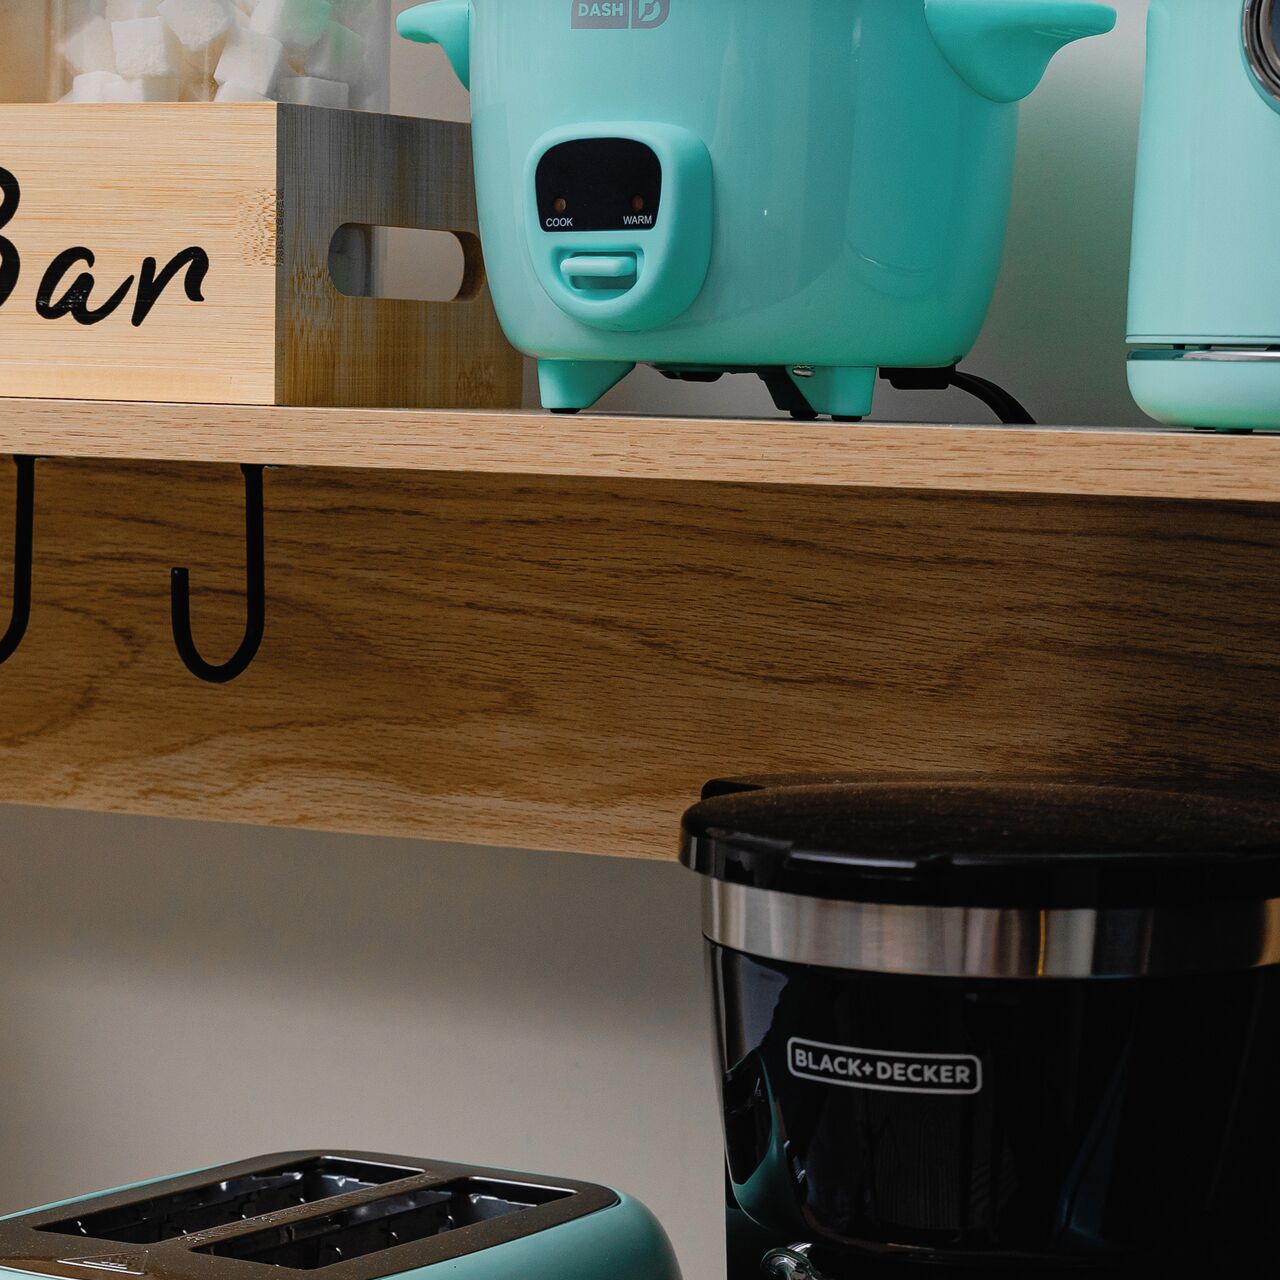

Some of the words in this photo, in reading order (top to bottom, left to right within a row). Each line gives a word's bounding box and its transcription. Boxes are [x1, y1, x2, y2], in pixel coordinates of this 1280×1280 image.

[578, 3, 624, 17] DASH
[545, 217, 573, 228] COOK
[623, 214, 653, 225] WARM
[794, 1048, 971, 1084] BLACK+DECKER
